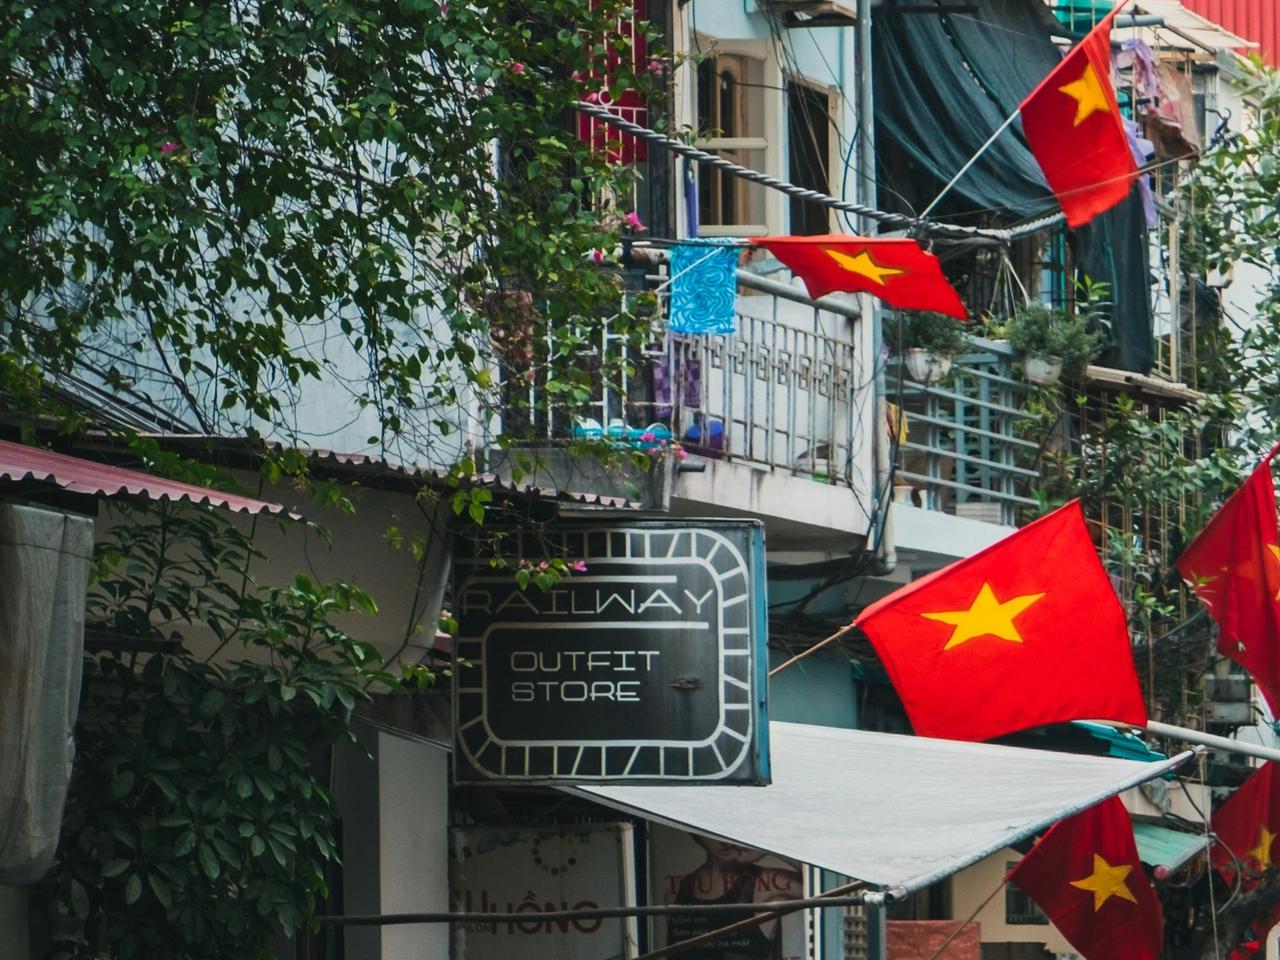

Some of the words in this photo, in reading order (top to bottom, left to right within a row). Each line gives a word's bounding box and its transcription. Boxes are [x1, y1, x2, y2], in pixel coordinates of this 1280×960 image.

[461, 588, 713, 614] RAILWAY
[510, 651, 660, 672] OUTFIT
[511, 681, 641, 702] STORE
